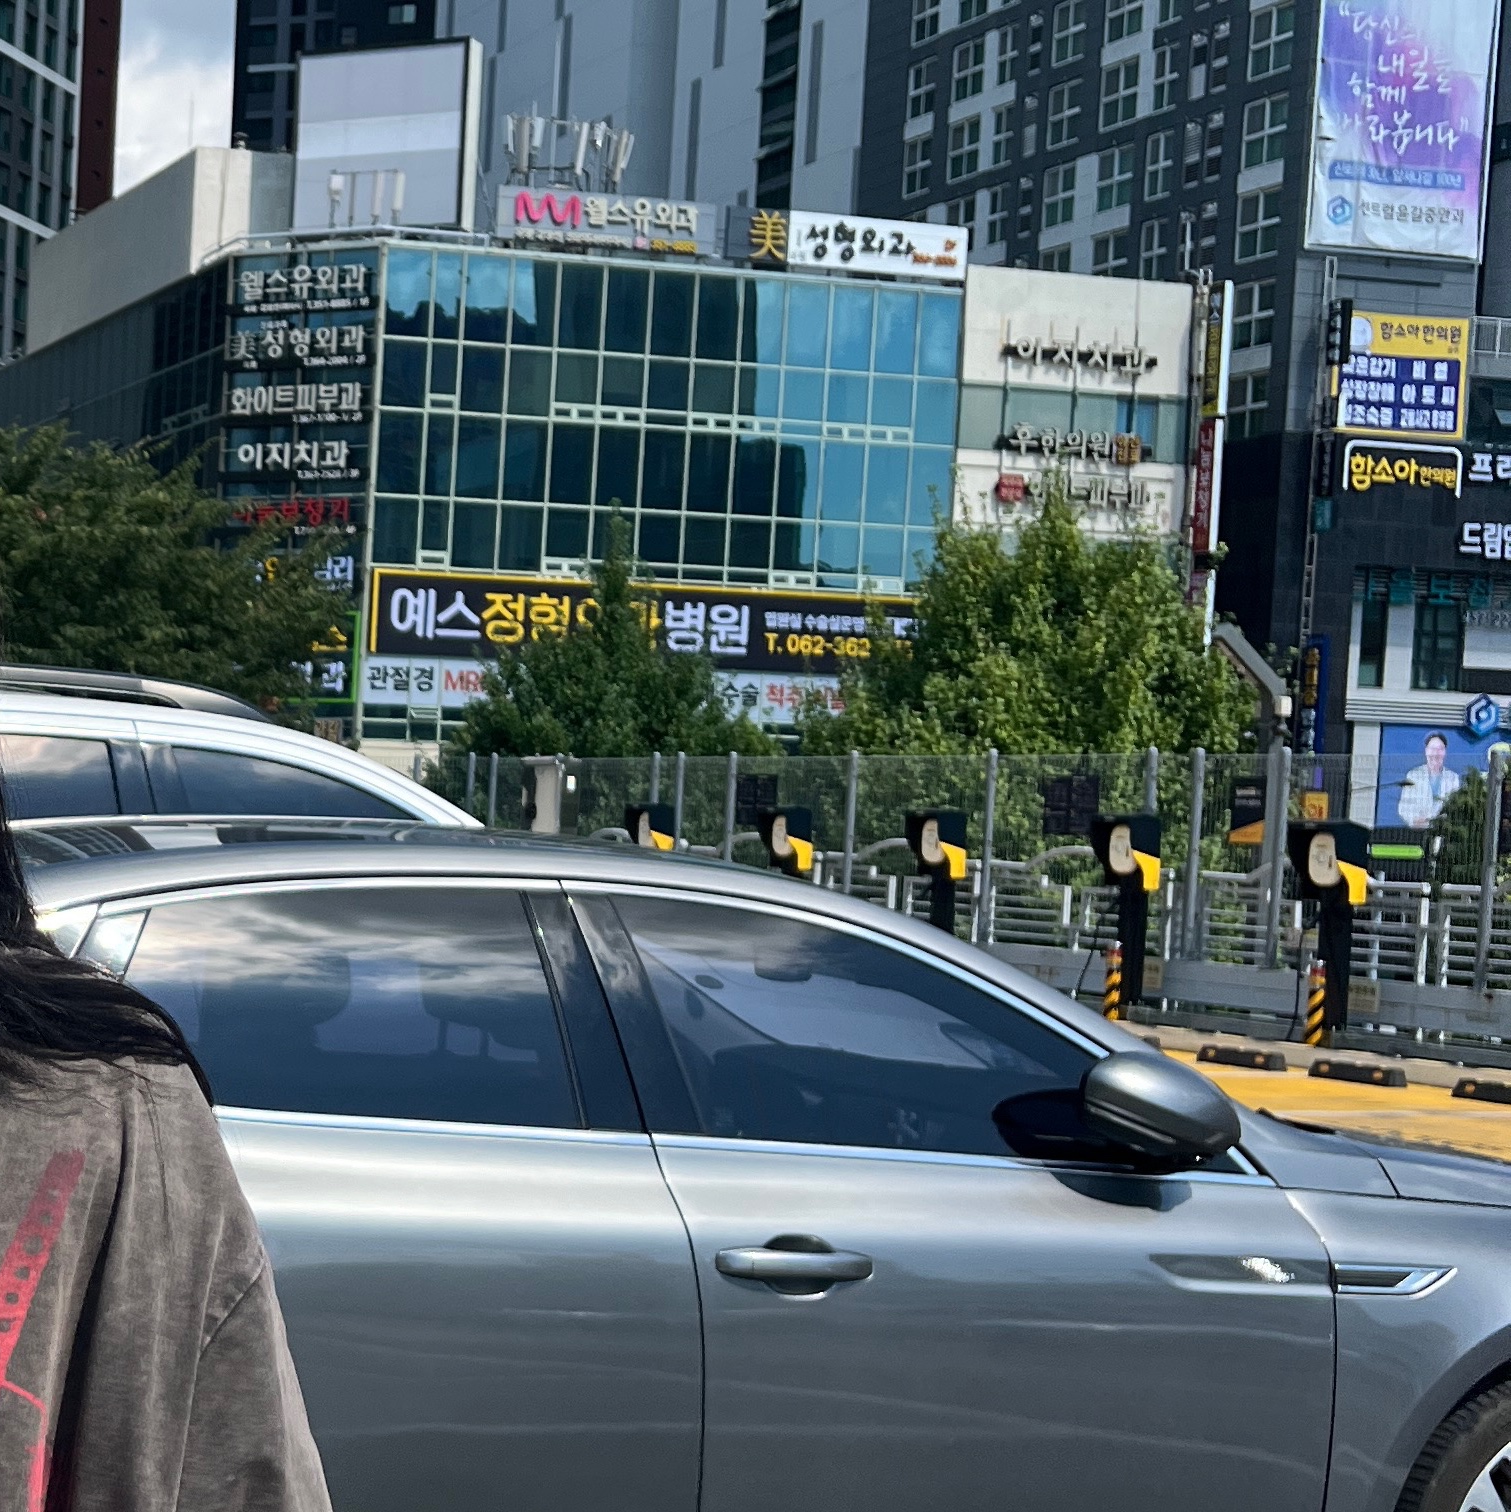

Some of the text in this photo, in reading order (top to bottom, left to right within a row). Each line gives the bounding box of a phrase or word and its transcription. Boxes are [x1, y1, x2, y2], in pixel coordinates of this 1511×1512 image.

[749, 209, 788, 262] 美
[807, 220, 916, 263] 성형외과
[260, 325, 366, 359] 성형외과
[1015, 337, 1148, 374] 이지치과
[231, 382, 362, 415] 화이트피부과
[237, 440, 350, 470] 이지치과
[367, 666, 435, 692] 관절경
[721, 682, 760, 708] 수술
